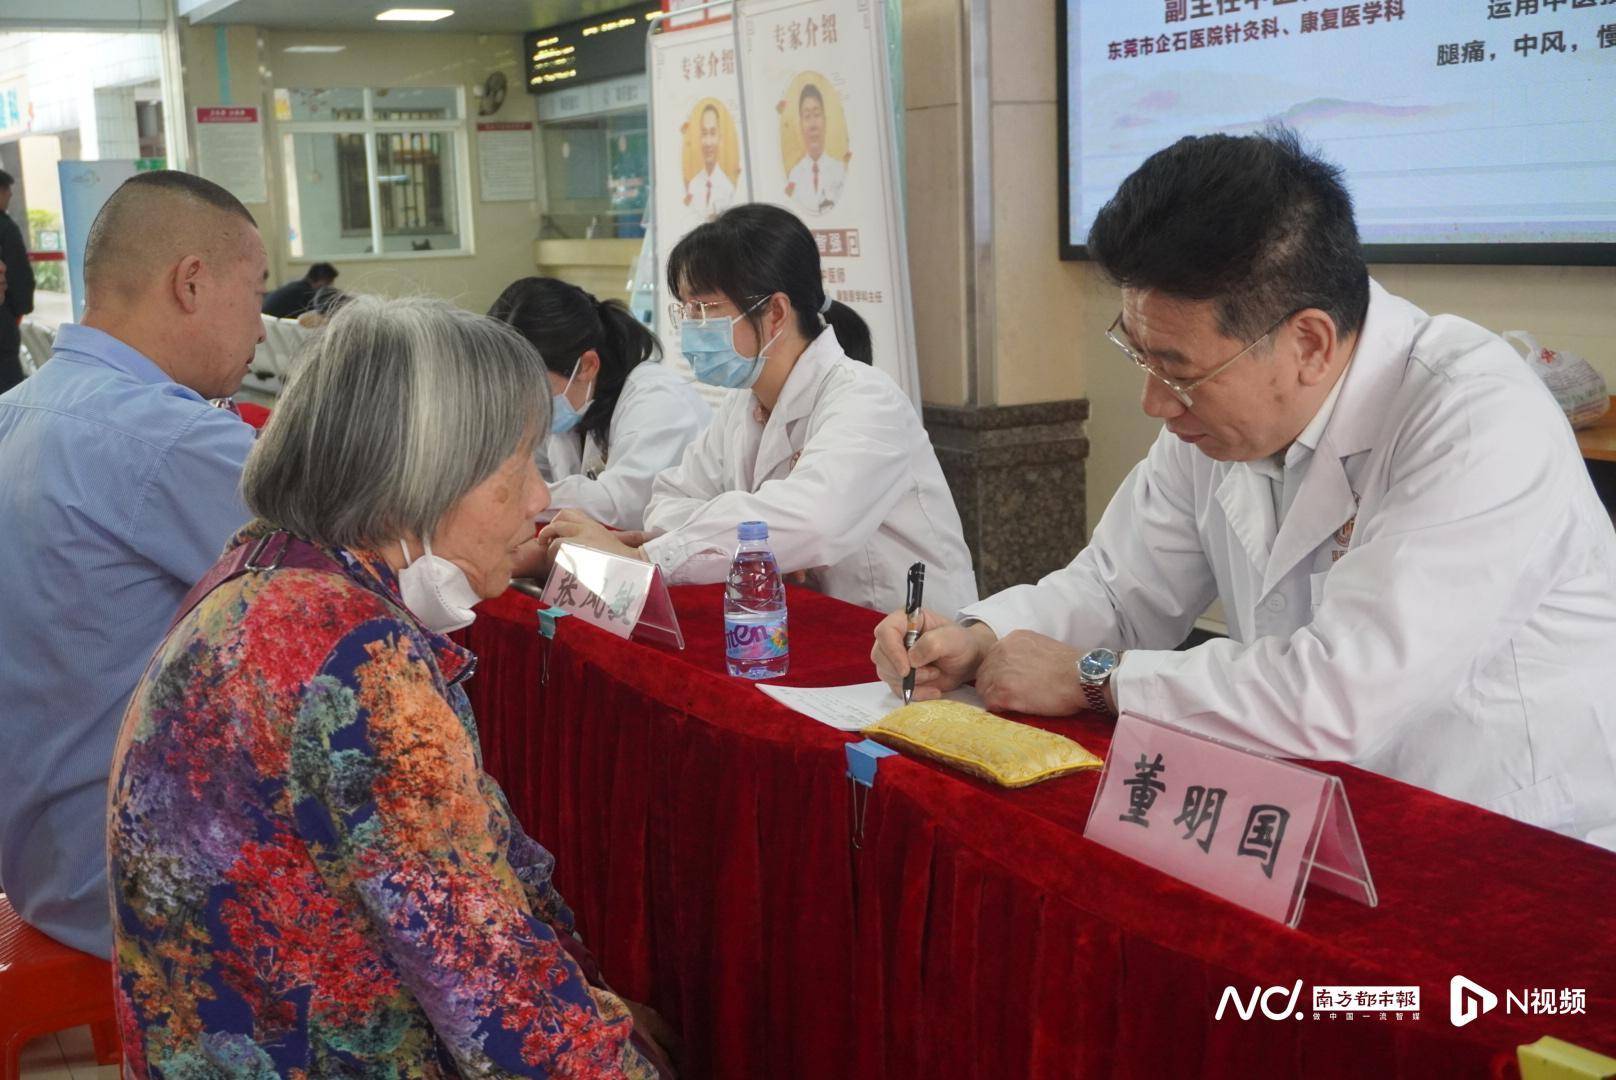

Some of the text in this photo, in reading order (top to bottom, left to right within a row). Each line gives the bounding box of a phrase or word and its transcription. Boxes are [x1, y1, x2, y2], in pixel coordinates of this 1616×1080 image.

[1107, 0, 1406, 60] 东莞市企石医院针灸科、康复医学科
[1165, 0, 1309, 23] 副主任
[774, 13, 838, 51] 专家介绍
[681, 48, 734, 80] 专家介绍
[1118, 752, 1290, 880] 董明国
